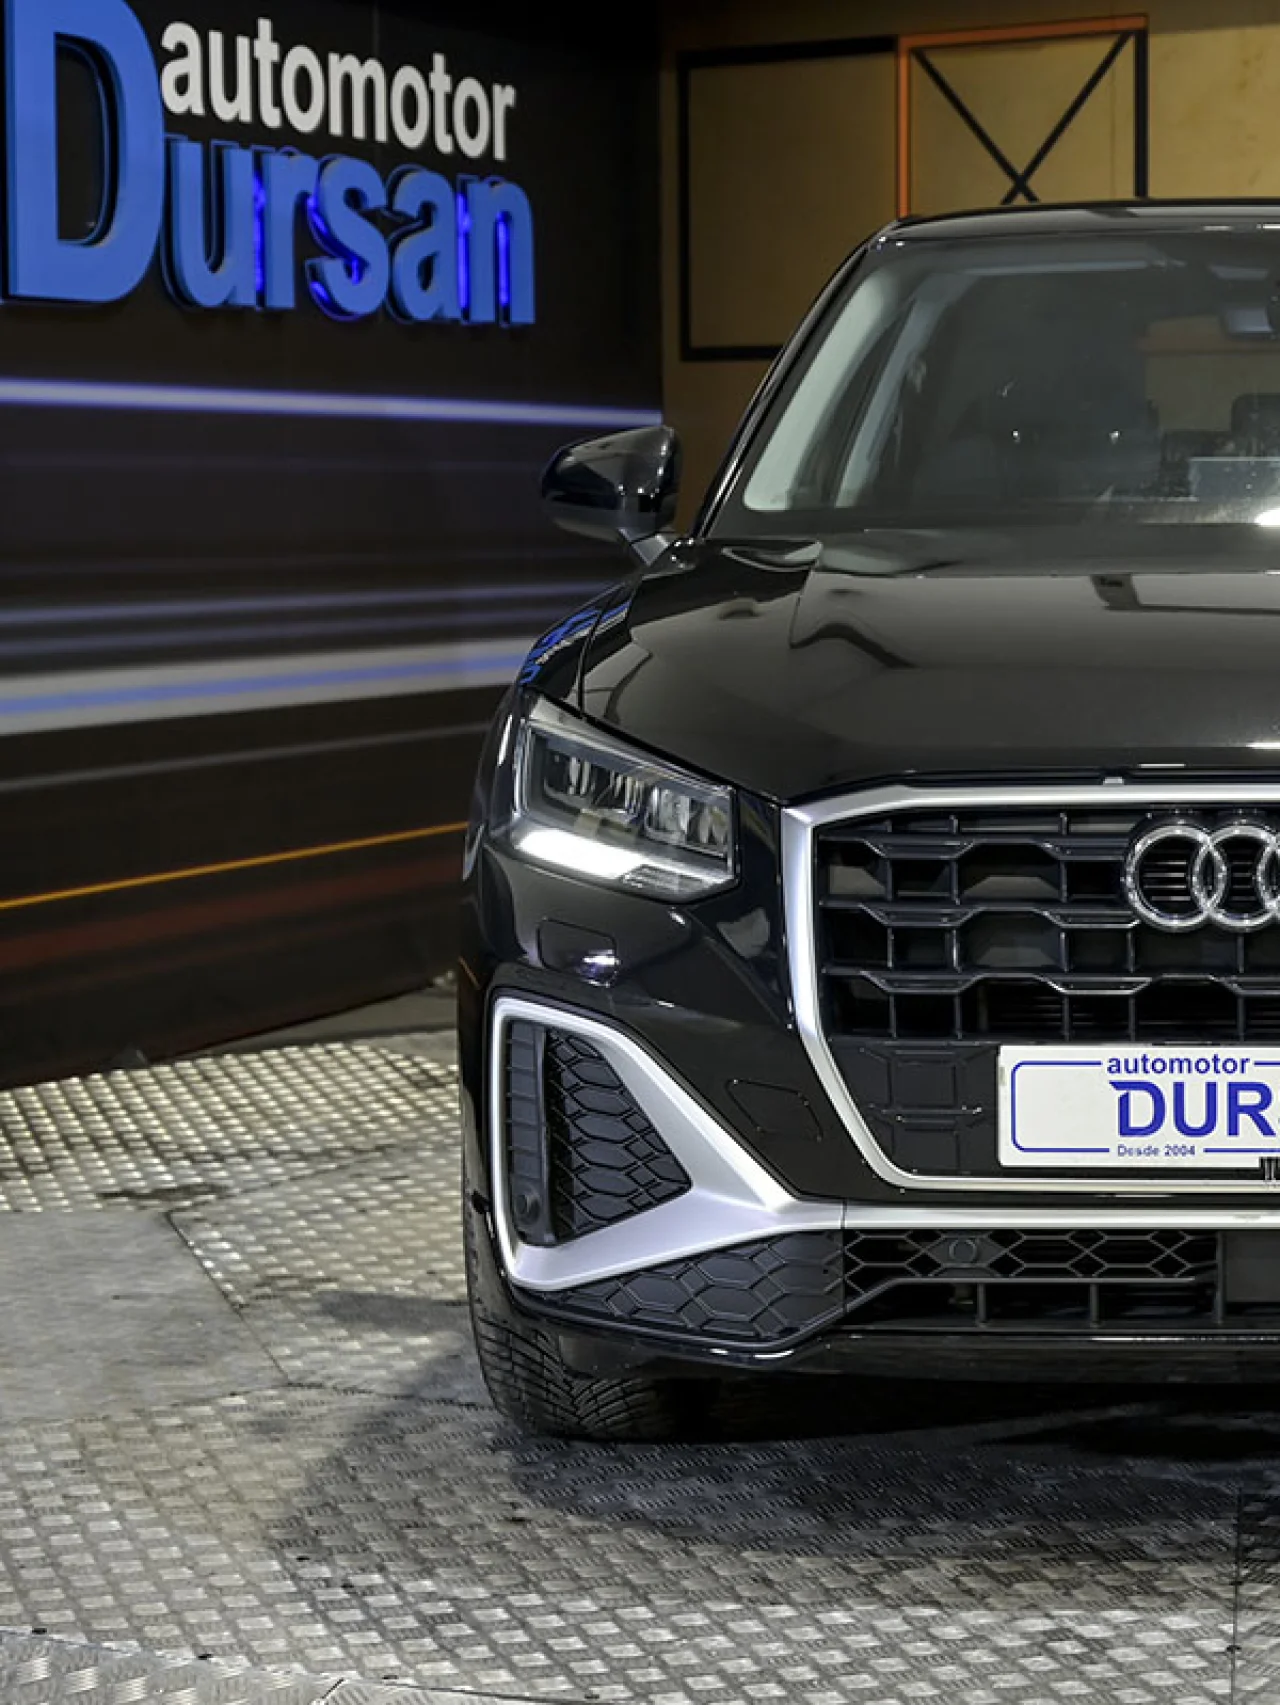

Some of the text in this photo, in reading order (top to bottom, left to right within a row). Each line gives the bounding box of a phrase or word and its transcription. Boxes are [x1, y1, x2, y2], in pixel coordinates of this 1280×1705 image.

[160, 17, 517, 161] automotor
[5, 0, 535, 326] Dursan
[1107, 1053, 1251, 1075] automotor
[1164, 1143, 1197, 1157] 2004
